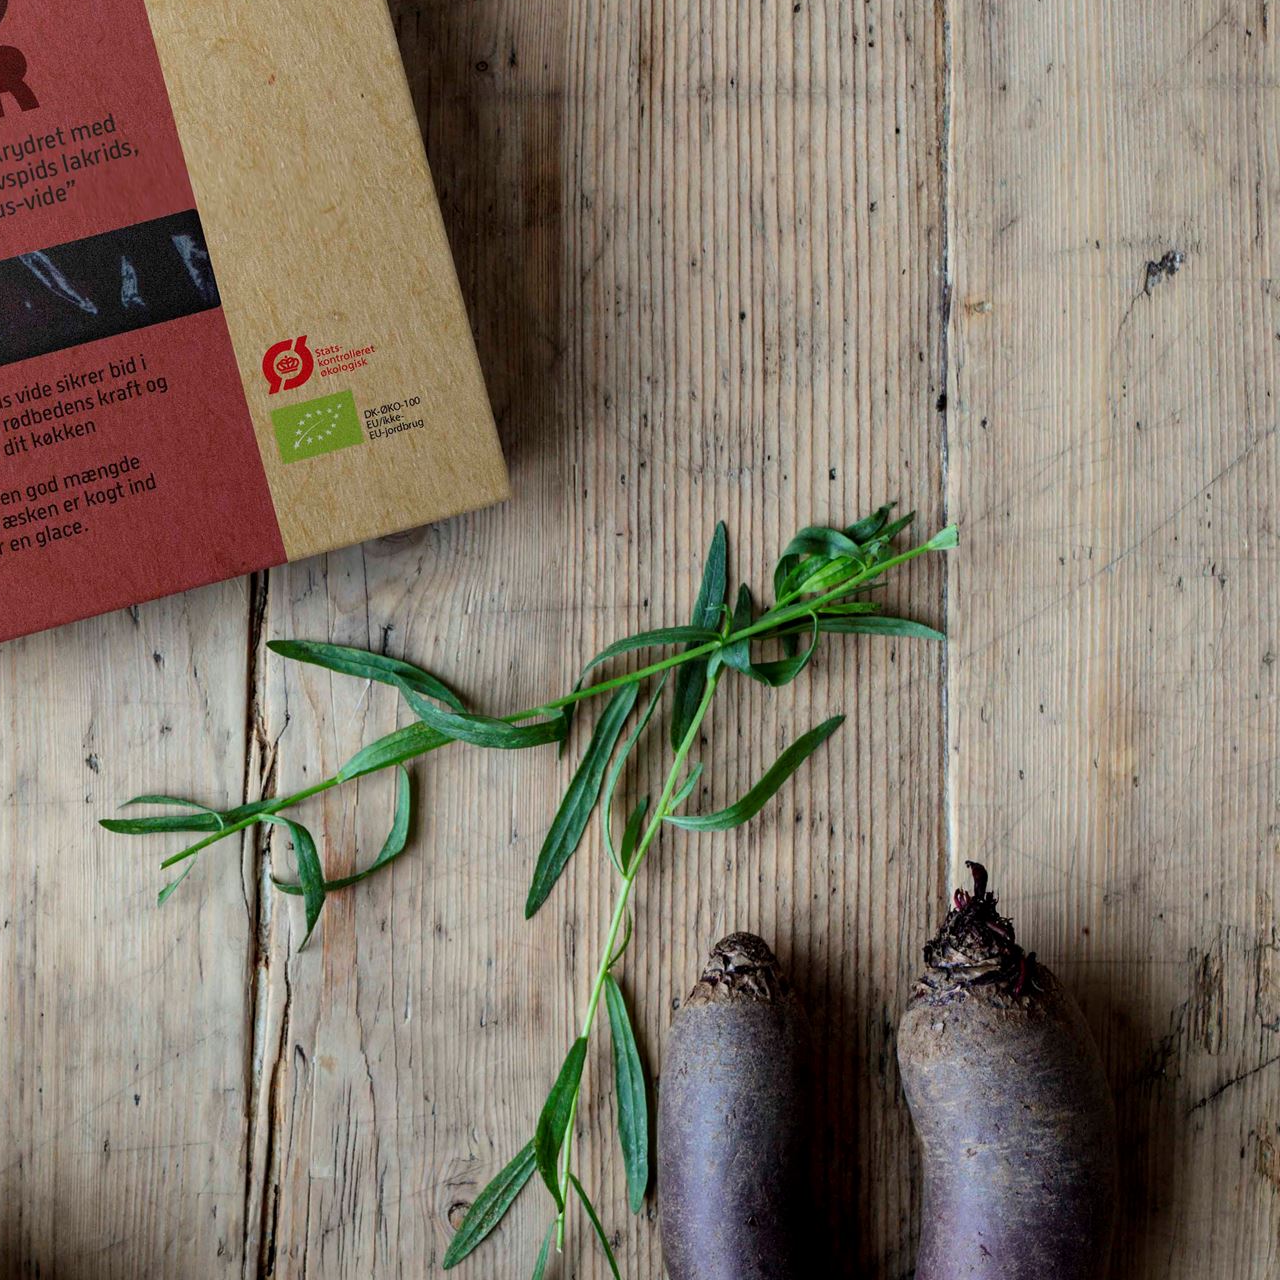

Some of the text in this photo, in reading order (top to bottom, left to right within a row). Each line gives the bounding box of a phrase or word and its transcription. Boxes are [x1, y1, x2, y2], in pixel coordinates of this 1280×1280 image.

[70, 112, 117, 143] med
[61, 139, 139, 173] lakrids,
[314, 345, 343, 358] Stats-
[317, 345, 376, 367] kontrolleret
[14, 382, 52, 404] vide
[55, 368, 105, 394] sikrer
[108, 356, 137, 379] bid
[139, 353, 148, 371] i
[320, 357, 368, 378] økologisk
[2, 396, 95, 433] rødbedens
[96, 379, 143, 407] kraft
[145, 377, 169, 394] og
[363, 396, 421, 420] DK-ØKO-100
[365, 413, 405, 430] EU/ikke-
[368, 418, 425, 441] EU-jordbrug
[3, 435, 29, 457] dit
[30, 420, 96, 449] køkken
[0, 489, 22, 506] en
[25, 475, 59, 502] god
[63, 455, 140, 489] mængde
[63, 496, 80, 513] er
[83, 481, 125, 507] kogt
[127, 472, 157, 495] ind
[9, 535, 32, 552] en
[35, 521, 89, 549] glace.
